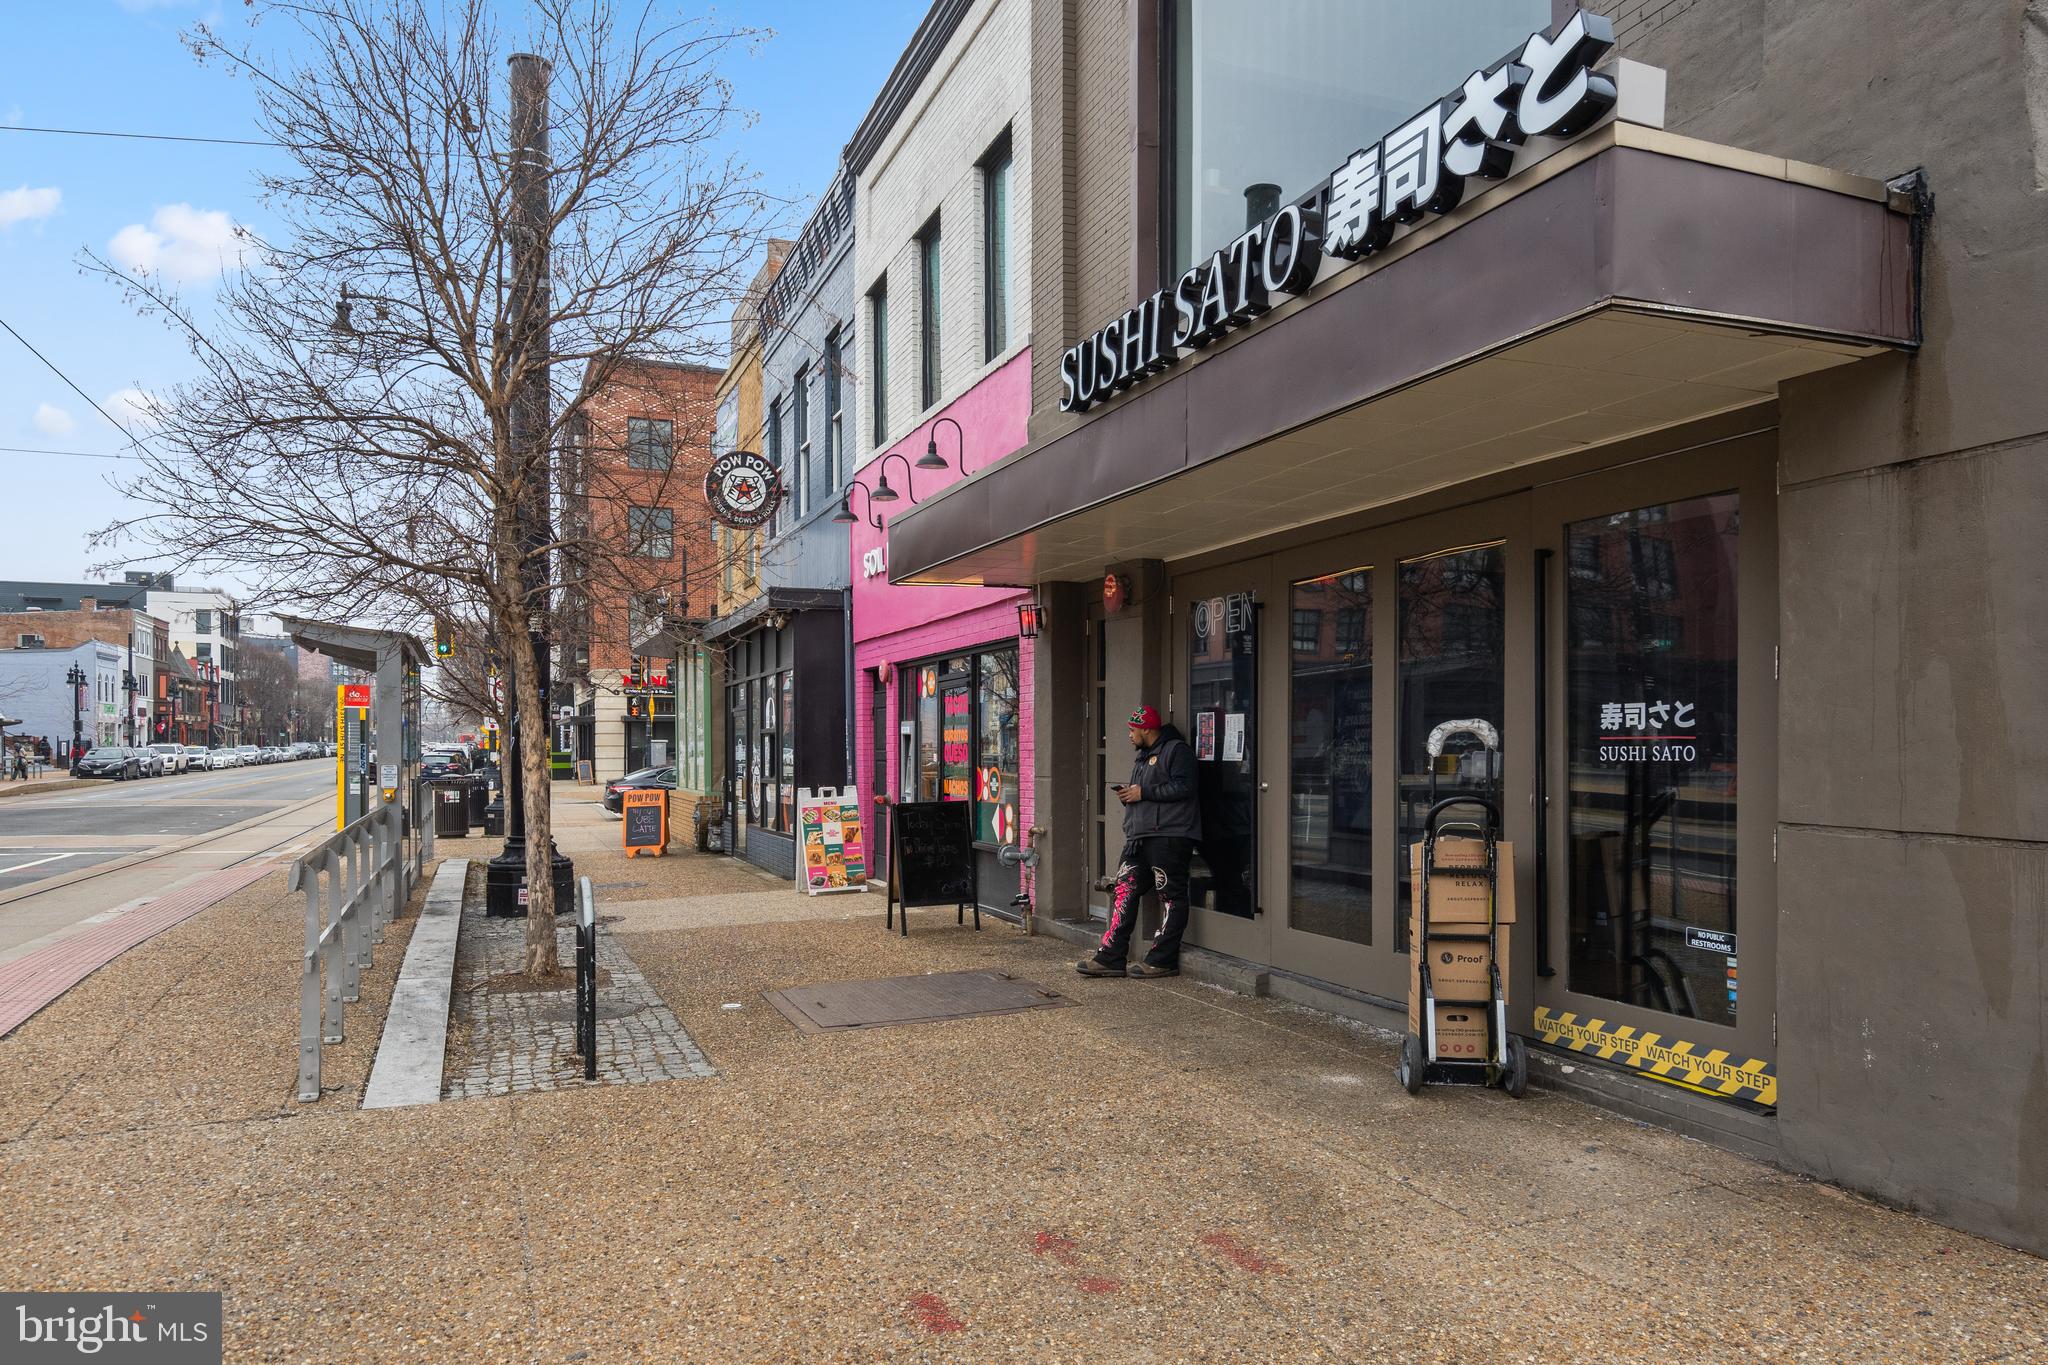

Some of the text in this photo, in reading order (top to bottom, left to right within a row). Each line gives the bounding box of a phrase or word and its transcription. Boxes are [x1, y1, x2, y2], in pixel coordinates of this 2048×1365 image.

[1320, 9, 1617, 259] 寿司さと
[1059, 204, 1306, 412] SUSHI SATO
[713, 455, 775, 480] POW POW
[1195, 590, 1256, 637] OPEN
[1600, 700, 1696, 730] 寿司さと
[1600, 745, 1696, 761] SUSHI SATO
[628, 793, 661, 802] POW POW
[944, 779, 968, 796] NACHOS
[1691, 938, 1732, 952] RESTROOMS
[1706, 932, 1725, 942] PUBLIC
[1457, 955, 1483, 963] Proof
[1538, 1019, 1771, 1090] WATCH YOUR STEP WATCH YOUR STEP
